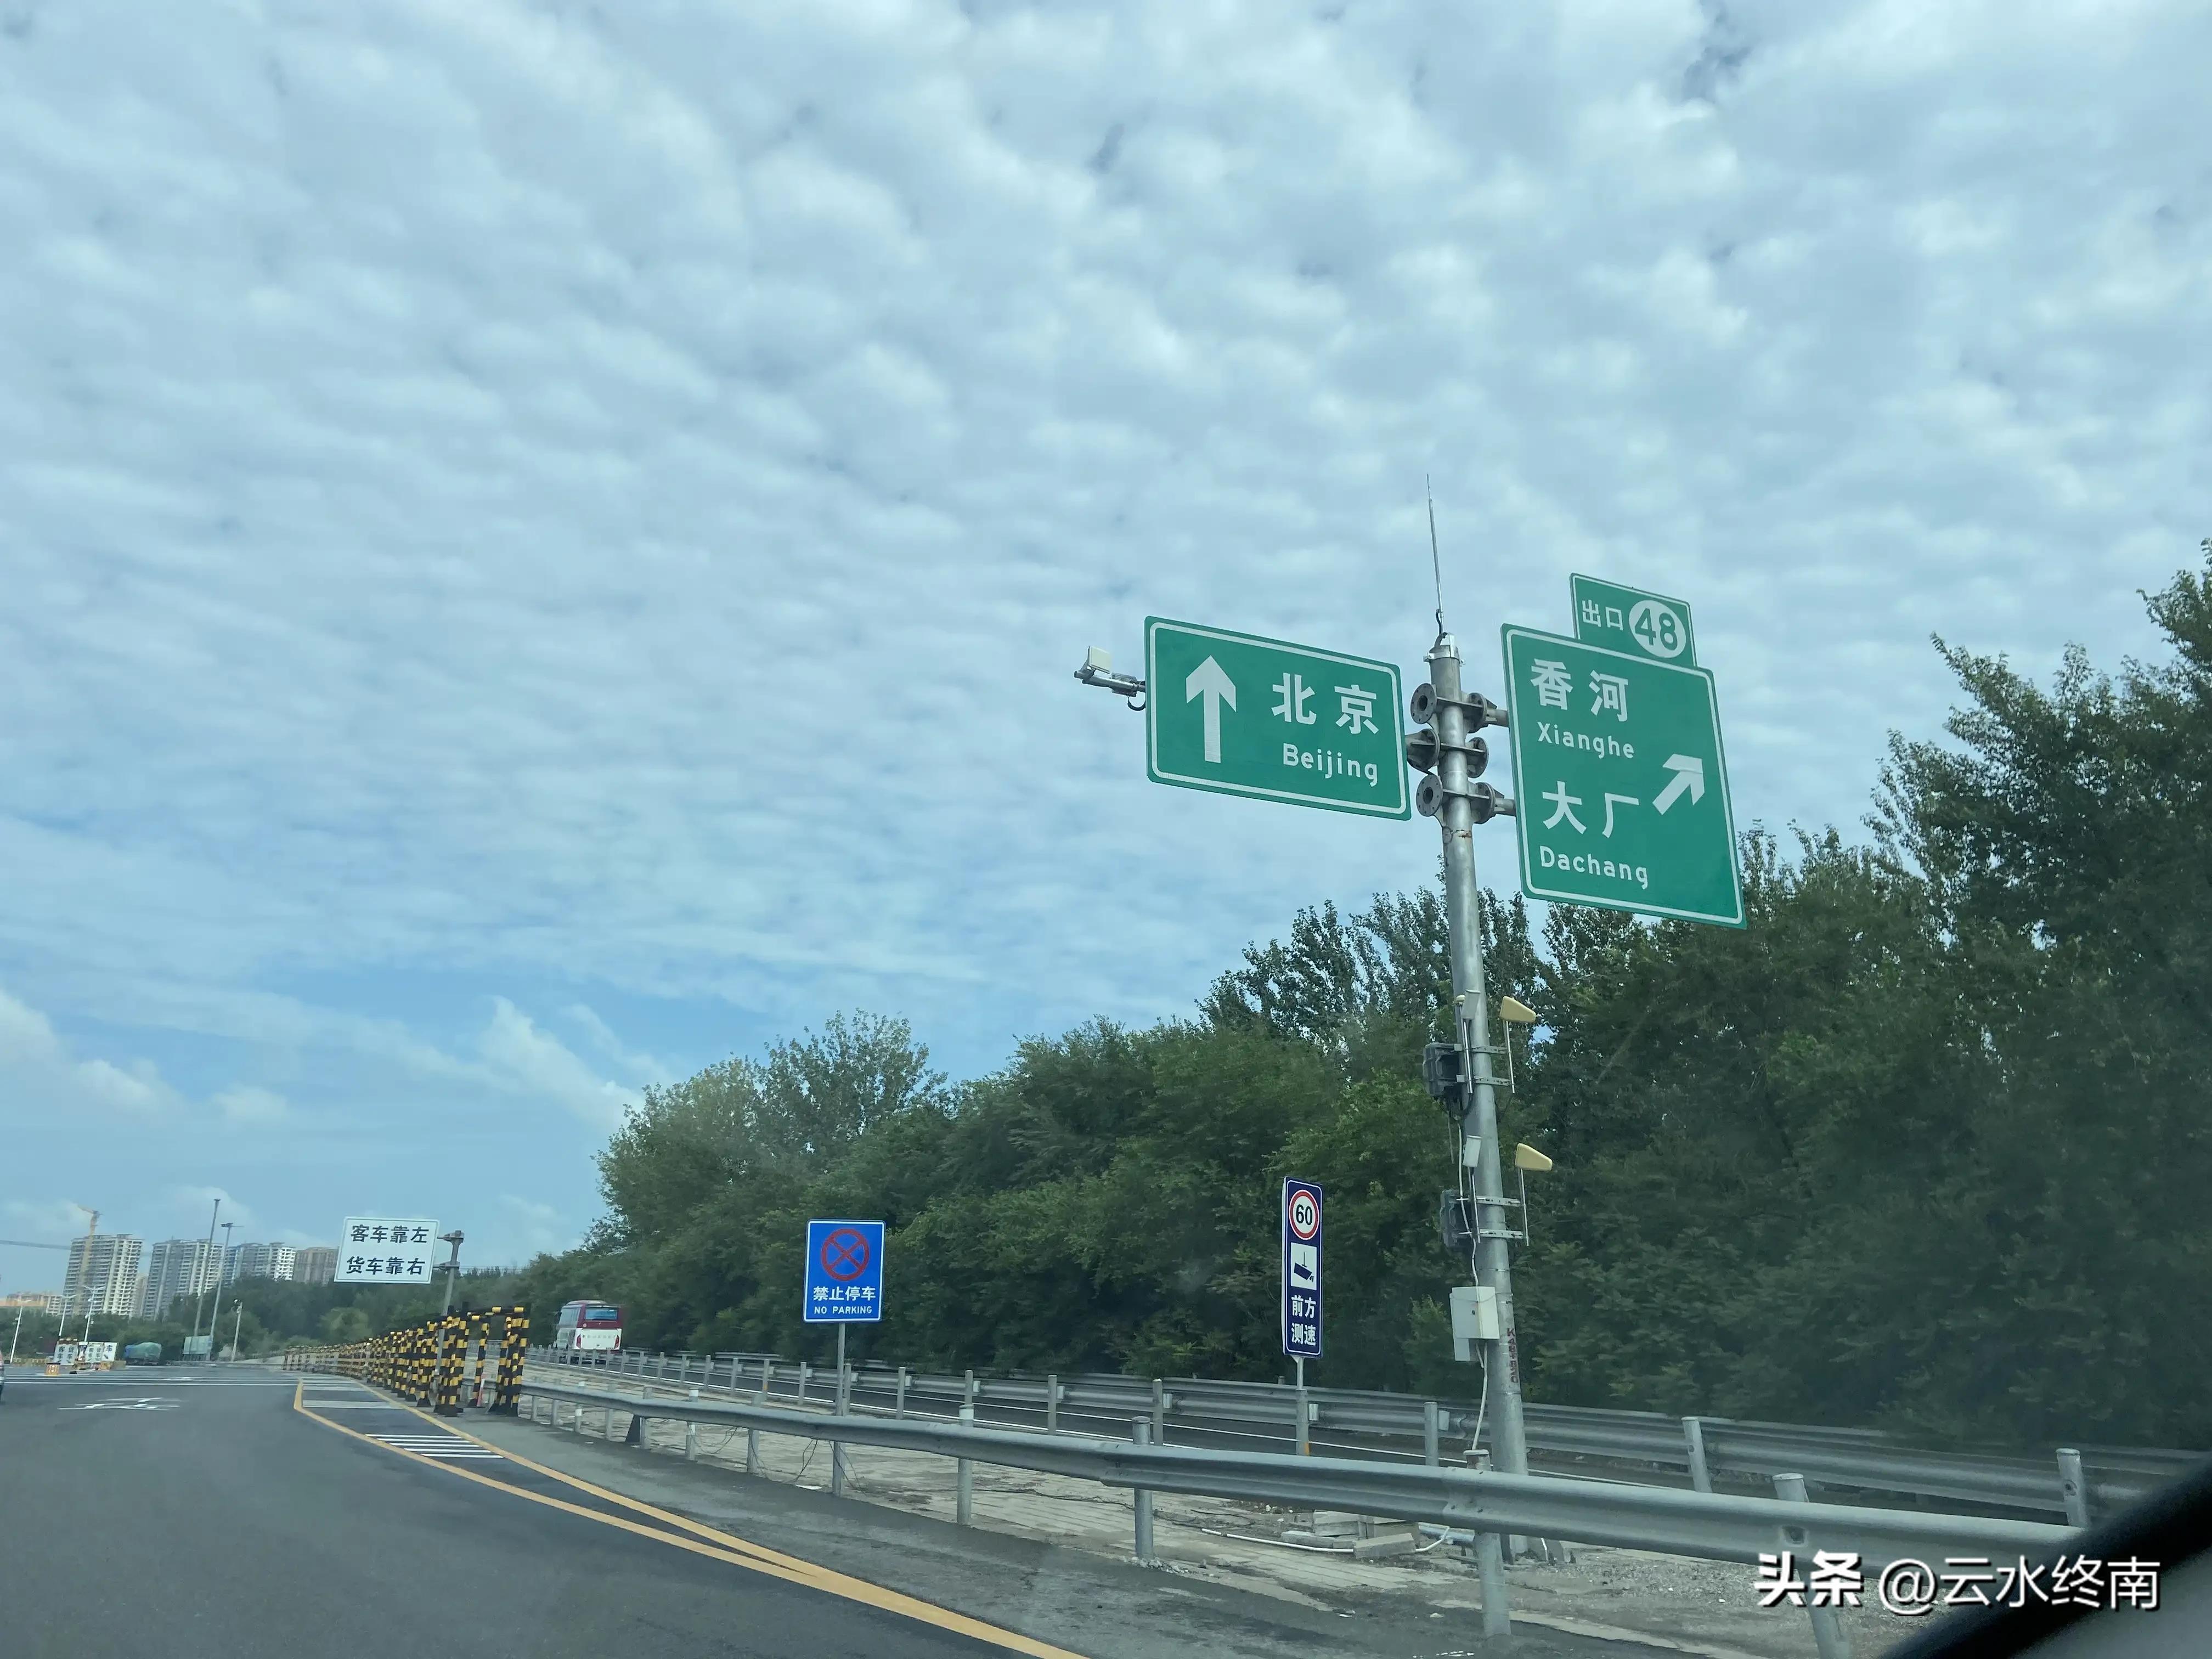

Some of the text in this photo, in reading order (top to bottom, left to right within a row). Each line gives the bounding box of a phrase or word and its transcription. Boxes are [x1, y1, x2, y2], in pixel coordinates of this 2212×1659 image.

[1582, 599, 1679, 651] 出口 48
[1271, 672, 1379, 735] 北京
[1530, 658, 1629, 722] 香河
[1537, 721, 1635, 759] Xianghe
[1283, 743, 1378, 787] Beijing
[1542, 781, 1640, 839] 大厂
[1539, 845, 1649, 890] Dachang
[1295, 1203, 1313, 1226] 60
[351, 1224, 429, 1244] 客车靠左
[346, 1256, 425, 1275] 货车靠右
[813, 1286, 876, 1301] 禁止停车
[1291, 1294, 1316, 1318] 前方
[814, 1306, 872, 1314] NO PARKING
[1291, 1322, 1316, 1346] 测速
